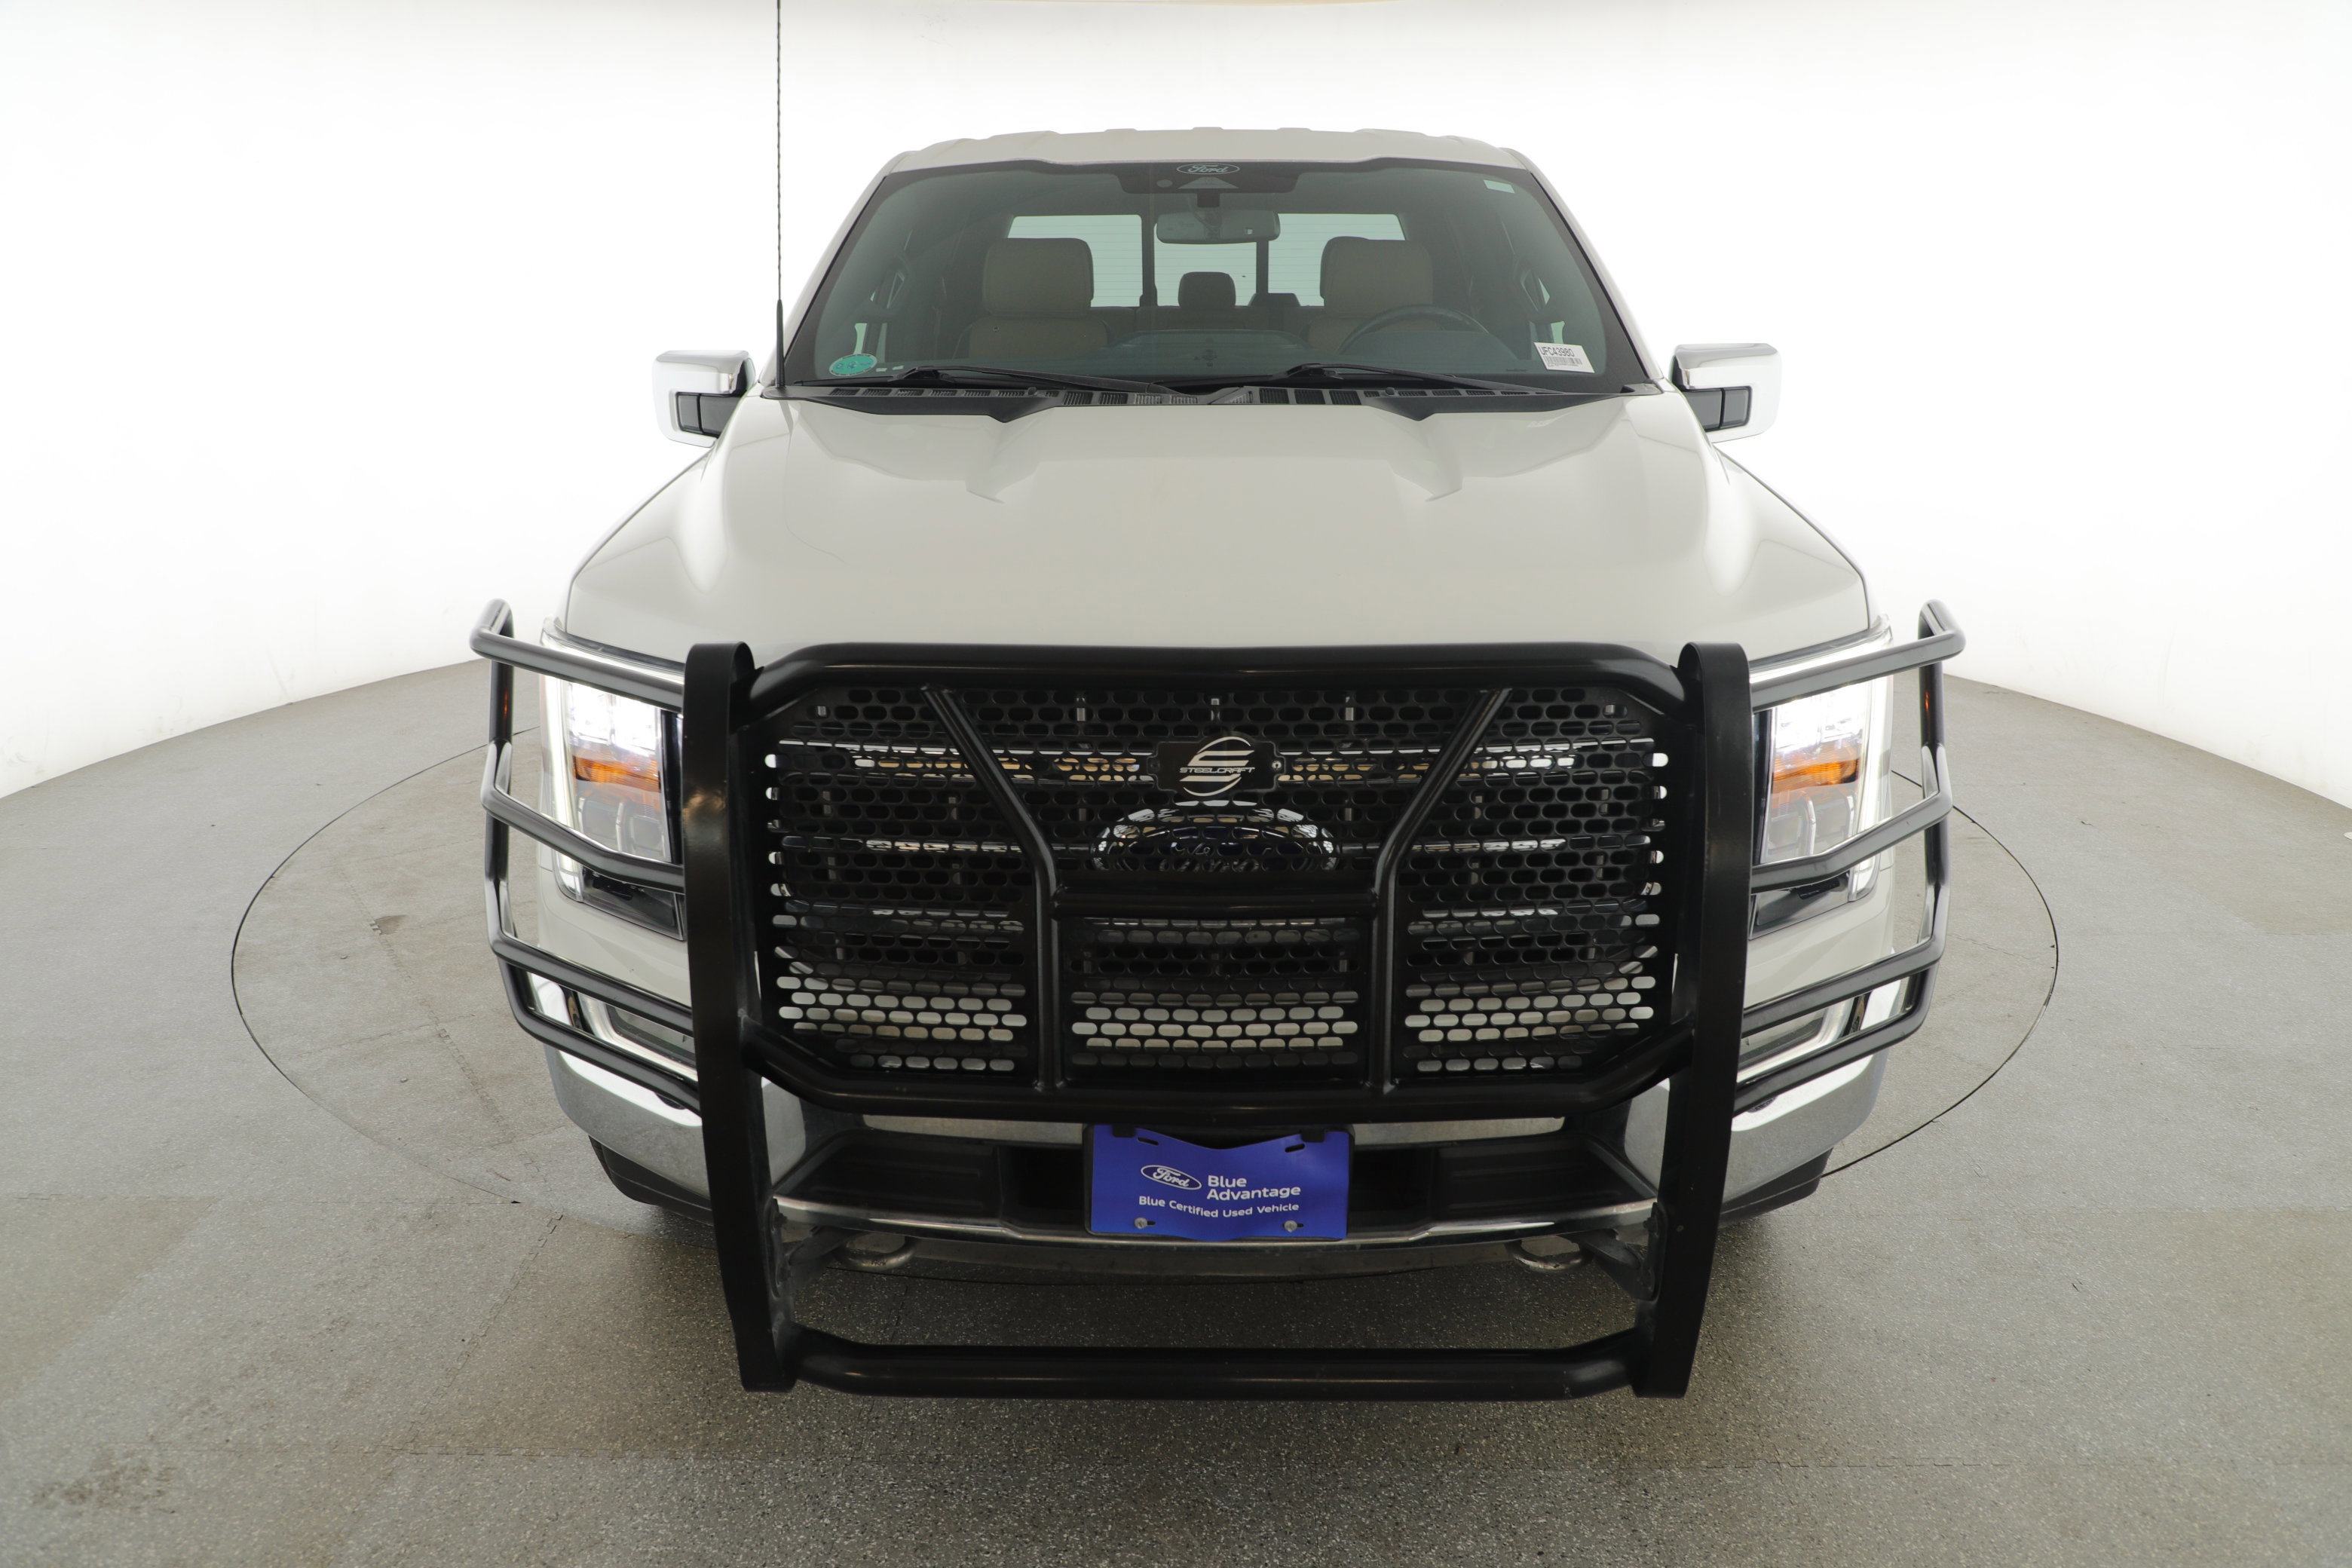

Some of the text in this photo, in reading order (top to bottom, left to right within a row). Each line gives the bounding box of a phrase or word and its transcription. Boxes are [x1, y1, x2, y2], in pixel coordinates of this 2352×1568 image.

[1187, 164, 1229, 173] Ford
[1152, 1167, 1190, 1188] Ford
[1207, 1174, 1248, 1188] Blue
[1206, 1186, 1301, 1201] Advantage
[1138, 1196, 1300, 1218] Blue Certified Used Vehicle
